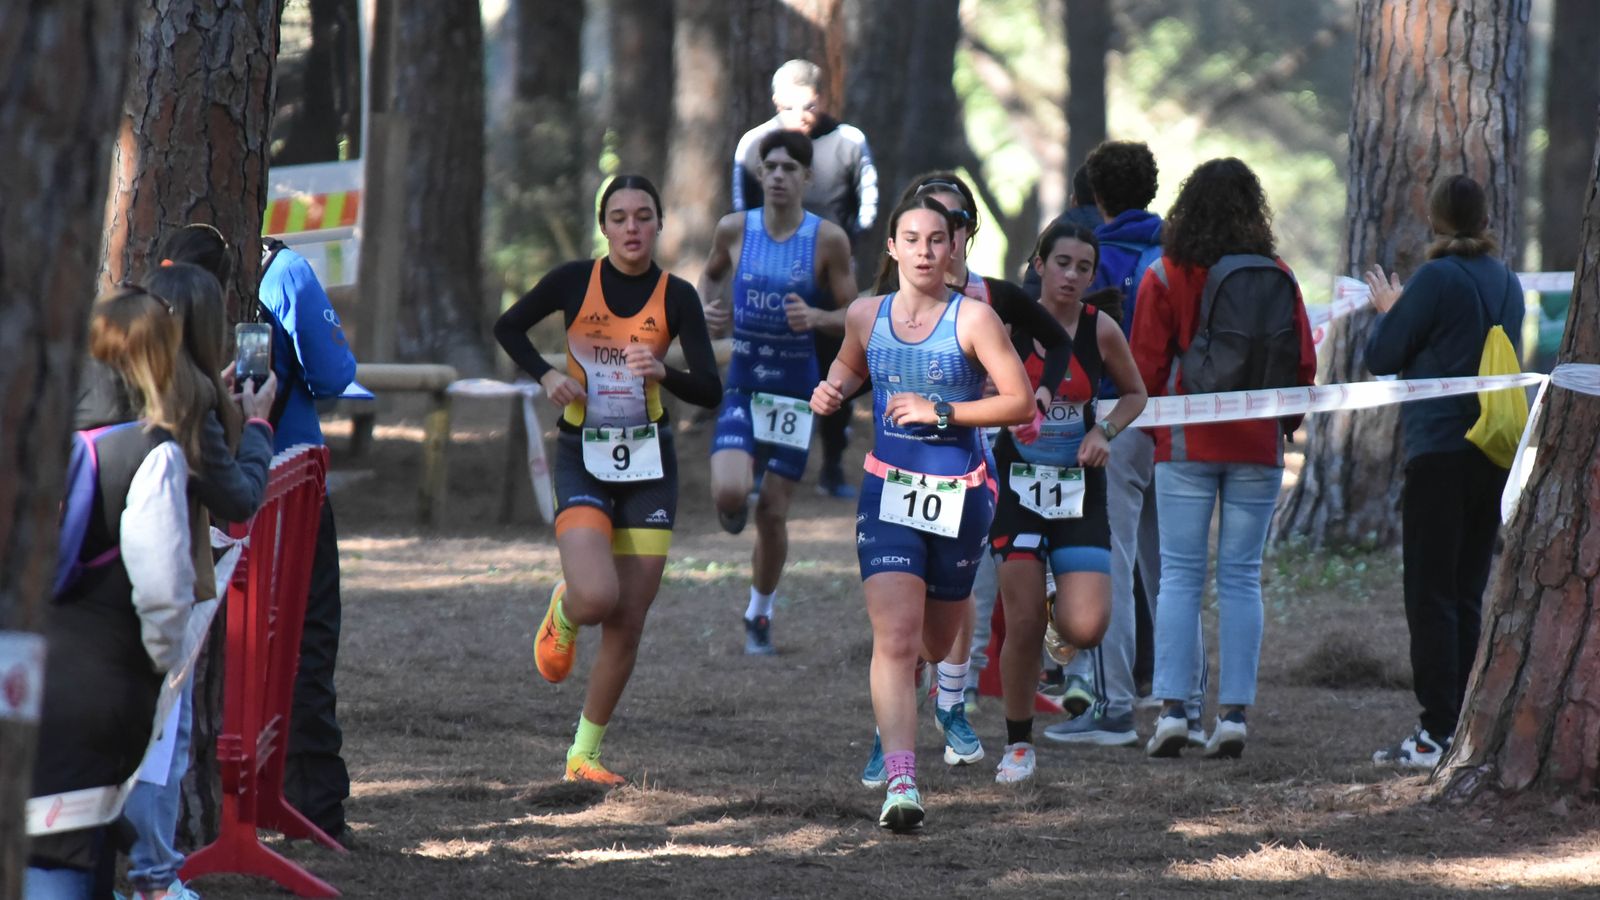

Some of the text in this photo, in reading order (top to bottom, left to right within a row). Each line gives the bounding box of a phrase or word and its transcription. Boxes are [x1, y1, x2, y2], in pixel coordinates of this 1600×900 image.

[766, 408, 797, 435] 18
[612, 444, 631, 471] 9
[903, 490, 942, 522] 10
[1029, 481, 1062, 507] 11
[882, 555, 911, 566] EDM
